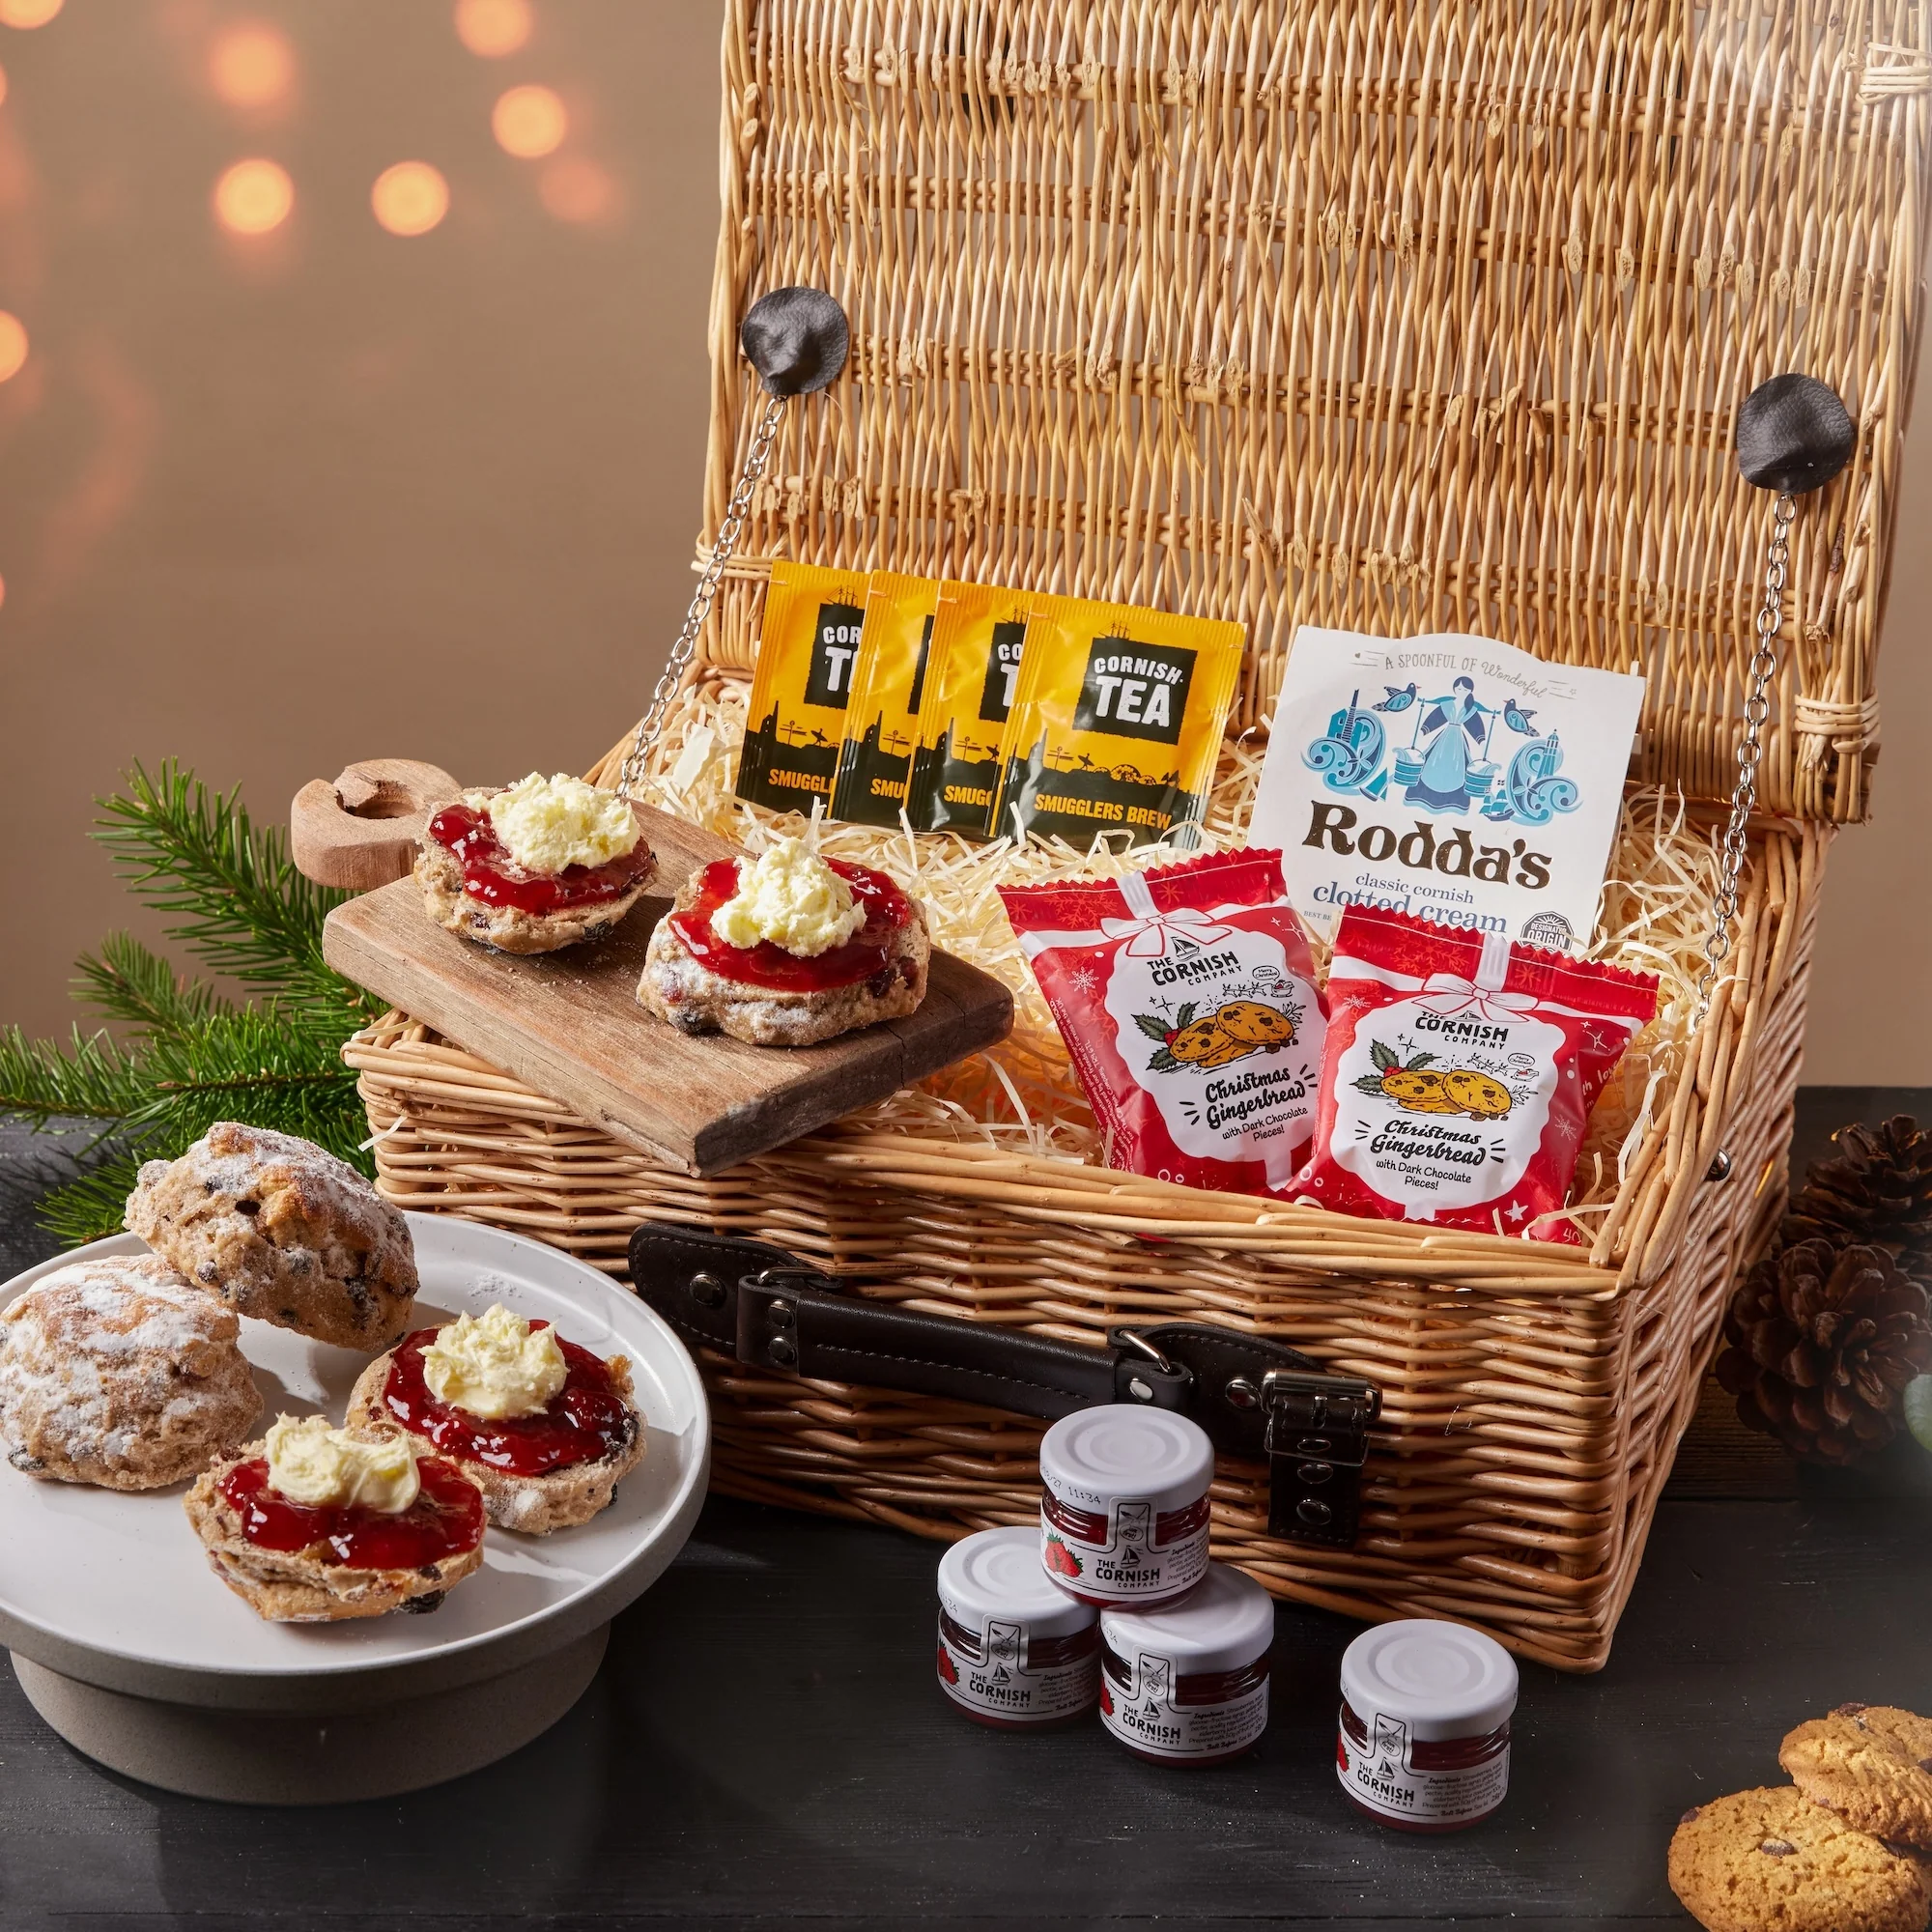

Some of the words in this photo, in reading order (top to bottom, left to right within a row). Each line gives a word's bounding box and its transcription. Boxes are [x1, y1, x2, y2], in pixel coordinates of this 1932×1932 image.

[1094, 656, 1183, 685] CORNISH
[1384, 656, 1395, 670] A
[1398, 653, 1458, 669] SPOONFUL
[1461, 658, 1478, 672] OF
[1481, 662, 1548, 698] Wonderful
[1094, 675, 1171, 727] TEA
[1034, 793, 1123, 820] SMUGGLERS
[1126, 809, 1172, 831] BREW
[1301, 799, 1552, 890] Rodda's
[1355, 872, 1409, 894] classic
[1413, 883, 1474, 904] cornish
[1419, 904, 1508, 934] cream
[1526, 929, 1567, 949] ORIGIN
[1147, 957, 1172, 971] THE
[1151, 951, 1240, 986] CORNISH
[1188, 965, 1243, 986] COMPANY
[1415, 1017, 1509, 1042] CORNISH
[1444, 1035, 1506, 1050] COMPANY
[1206, 1065, 1291, 1103] Christmas
[1206, 1082, 1306, 1130] Gingerbread
[1222, 1125, 1241, 1140] with
[1242, 1119, 1264, 1133] Dark
[1265, 1107, 1308, 1127] Chocolate
[1253, 1125, 1285, 1143] Pieces!
[1384, 1119, 1482, 1145] Christmas
[1370, 1133, 1487, 1166] Gingerbread
[1376, 1158, 1397, 1172] with
[1398, 1161, 1422, 1176] Dark
[1424, 1167, 1472, 1184] Chocolate
[1405, 1176, 1439, 1191] Pieces!
[1068, 1487, 1101, 1505] 11:34
[1095, 1567, 1160, 1582] CORNISH
[1097, 1559, 1116, 1570] THE
[971, 1671, 987, 1684] THE
[969, 1679, 1031, 1702] CORNISH
[988, 1697, 1031, 1708] COMPANY
[1123, 1704, 1138, 1718] THE
[1122, 1713, 1180, 1740] CORNISH
[1139, 1731, 1180, 1746] COMPANY
[1359, 1762, 1374, 1776] THE
[1357, 1770, 1414, 1802] CORNISH
[1373, 1792, 1413, 1807] COMPANY
